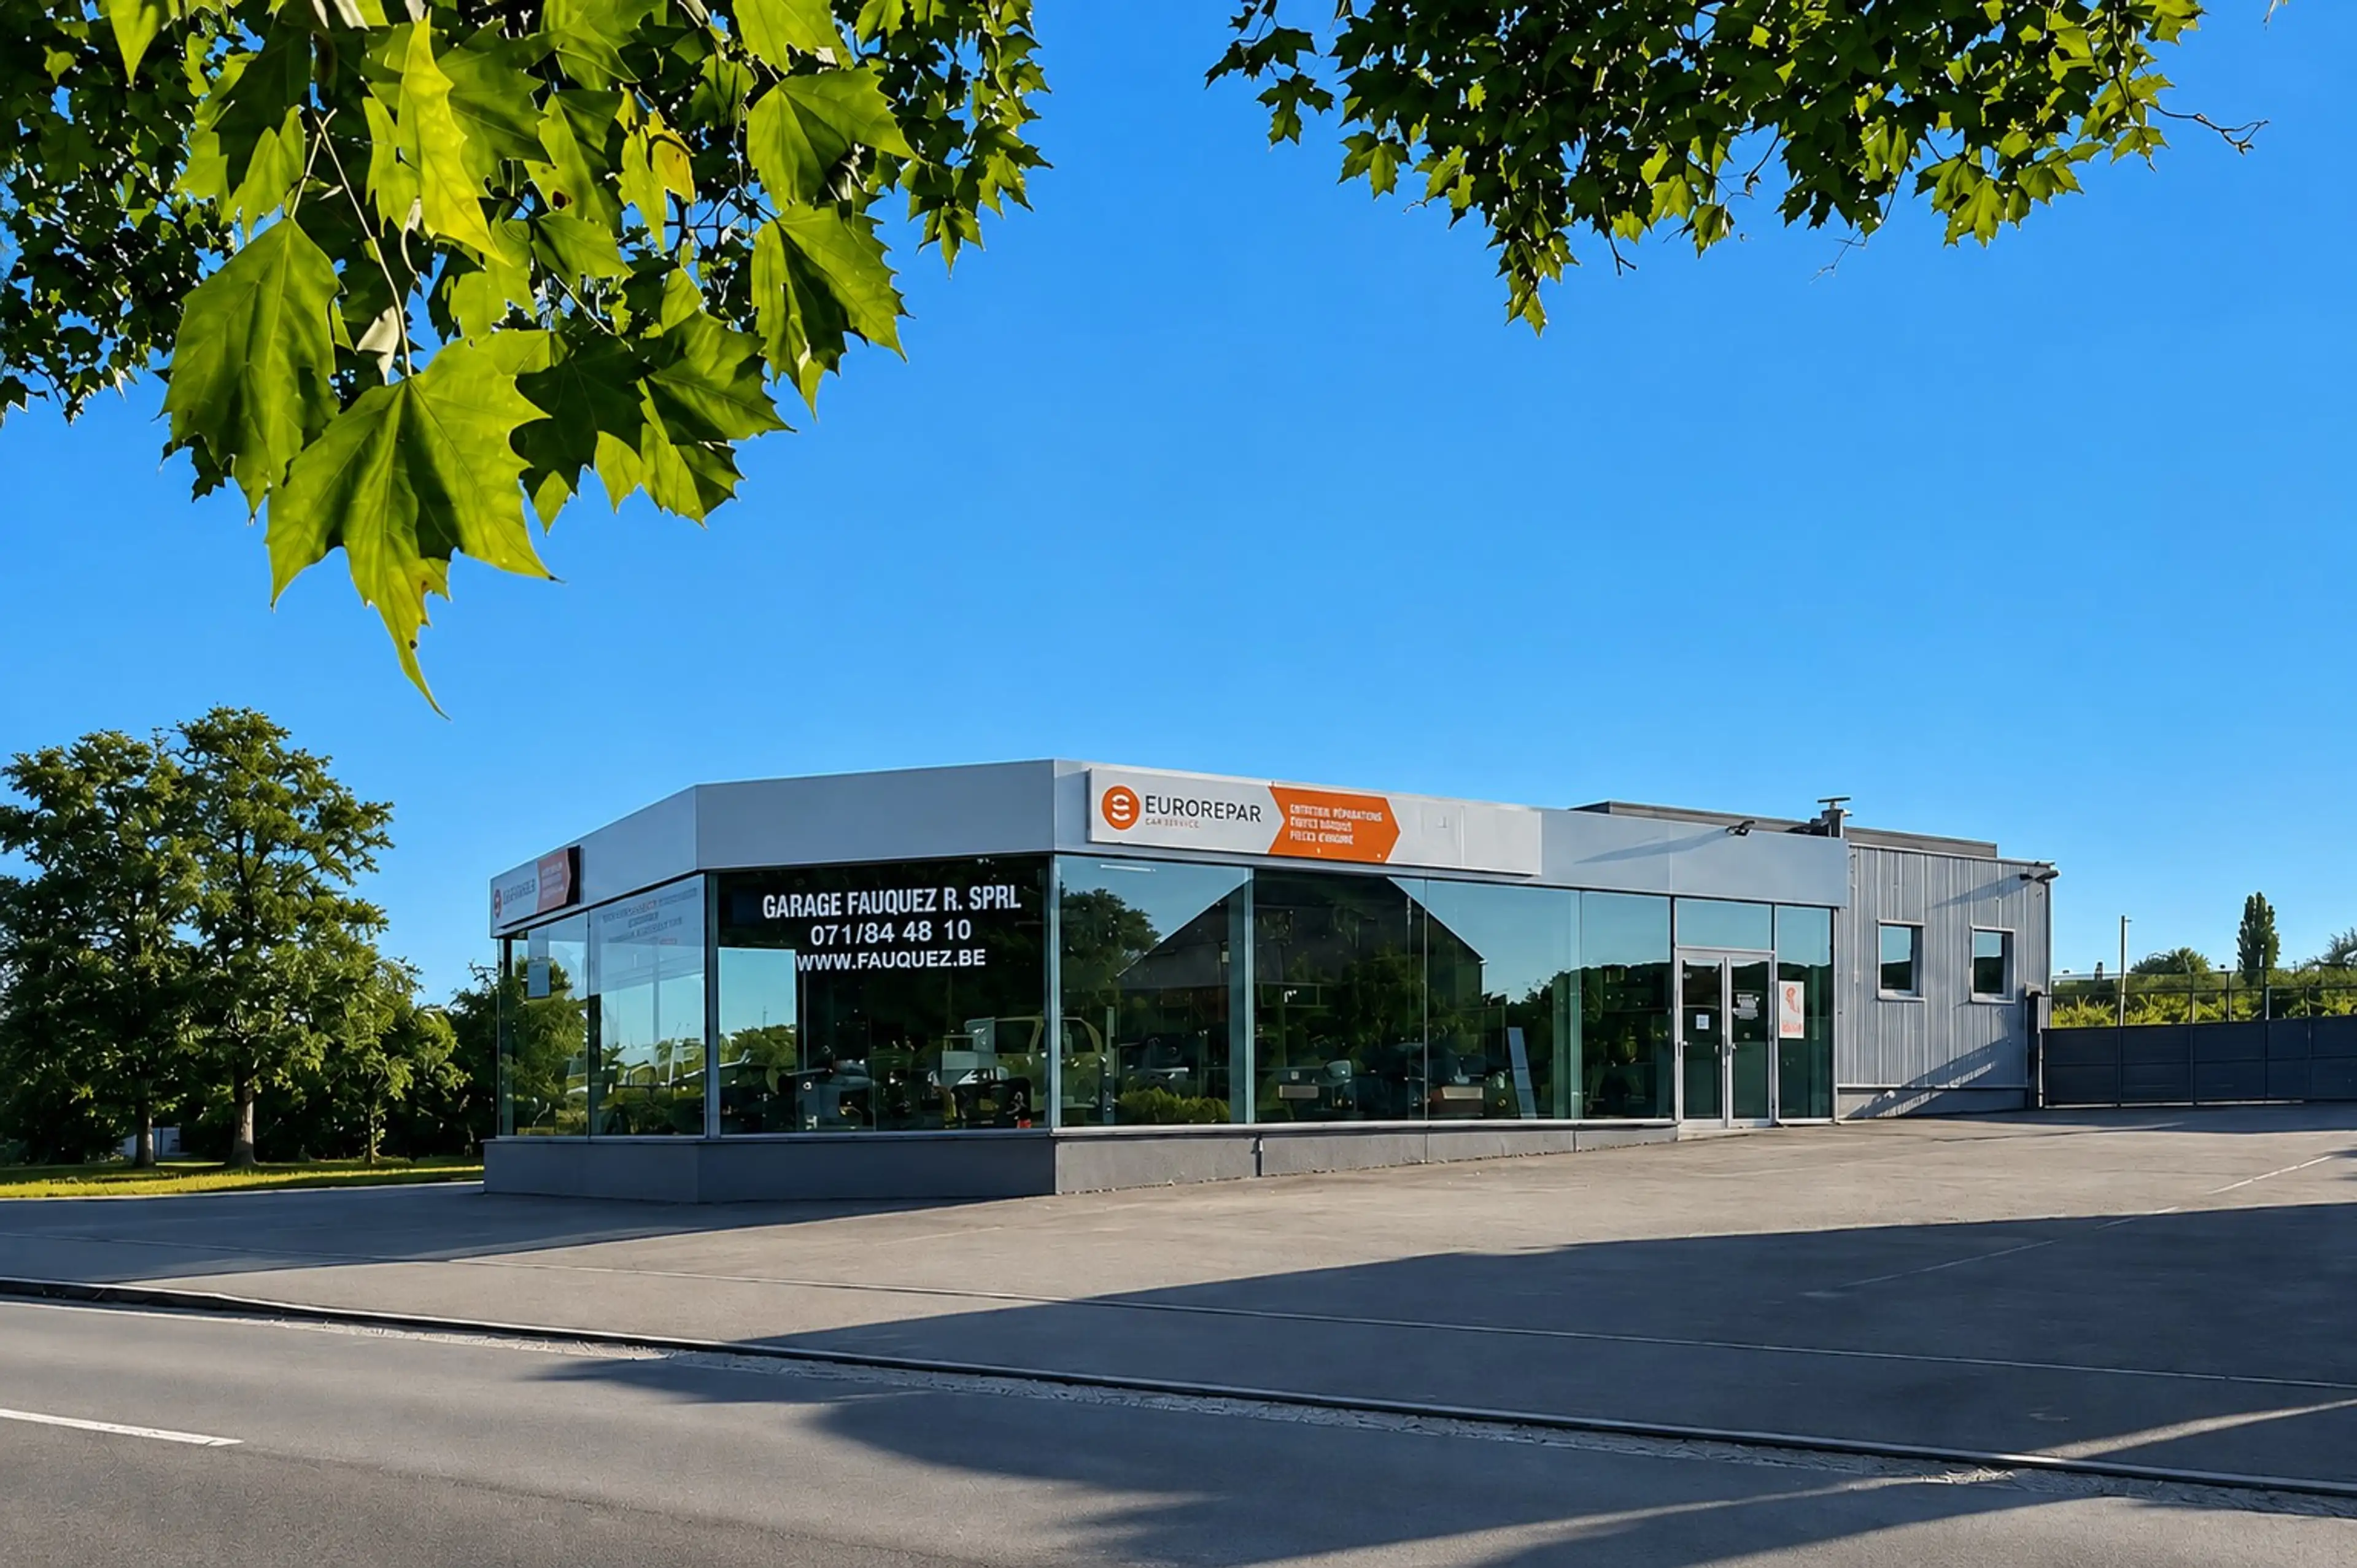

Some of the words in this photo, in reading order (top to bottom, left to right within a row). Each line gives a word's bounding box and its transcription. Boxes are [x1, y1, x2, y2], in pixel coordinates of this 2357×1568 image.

[1145, 795, 1262, 822] EUROREPAR
[762, 892, 842, 919] GARAGE
[848, 888, 937, 916] FAUQUEZ
[944, 887, 963, 911] R.
[969, 884, 1021, 910] SPRL
[811, 922, 895, 946] 071/84
[902, 920, 932, 942] 48
[944, 919, 971, 940] 10
[796, 948, 986, 971] WWW.FAUQUEZ.BE
